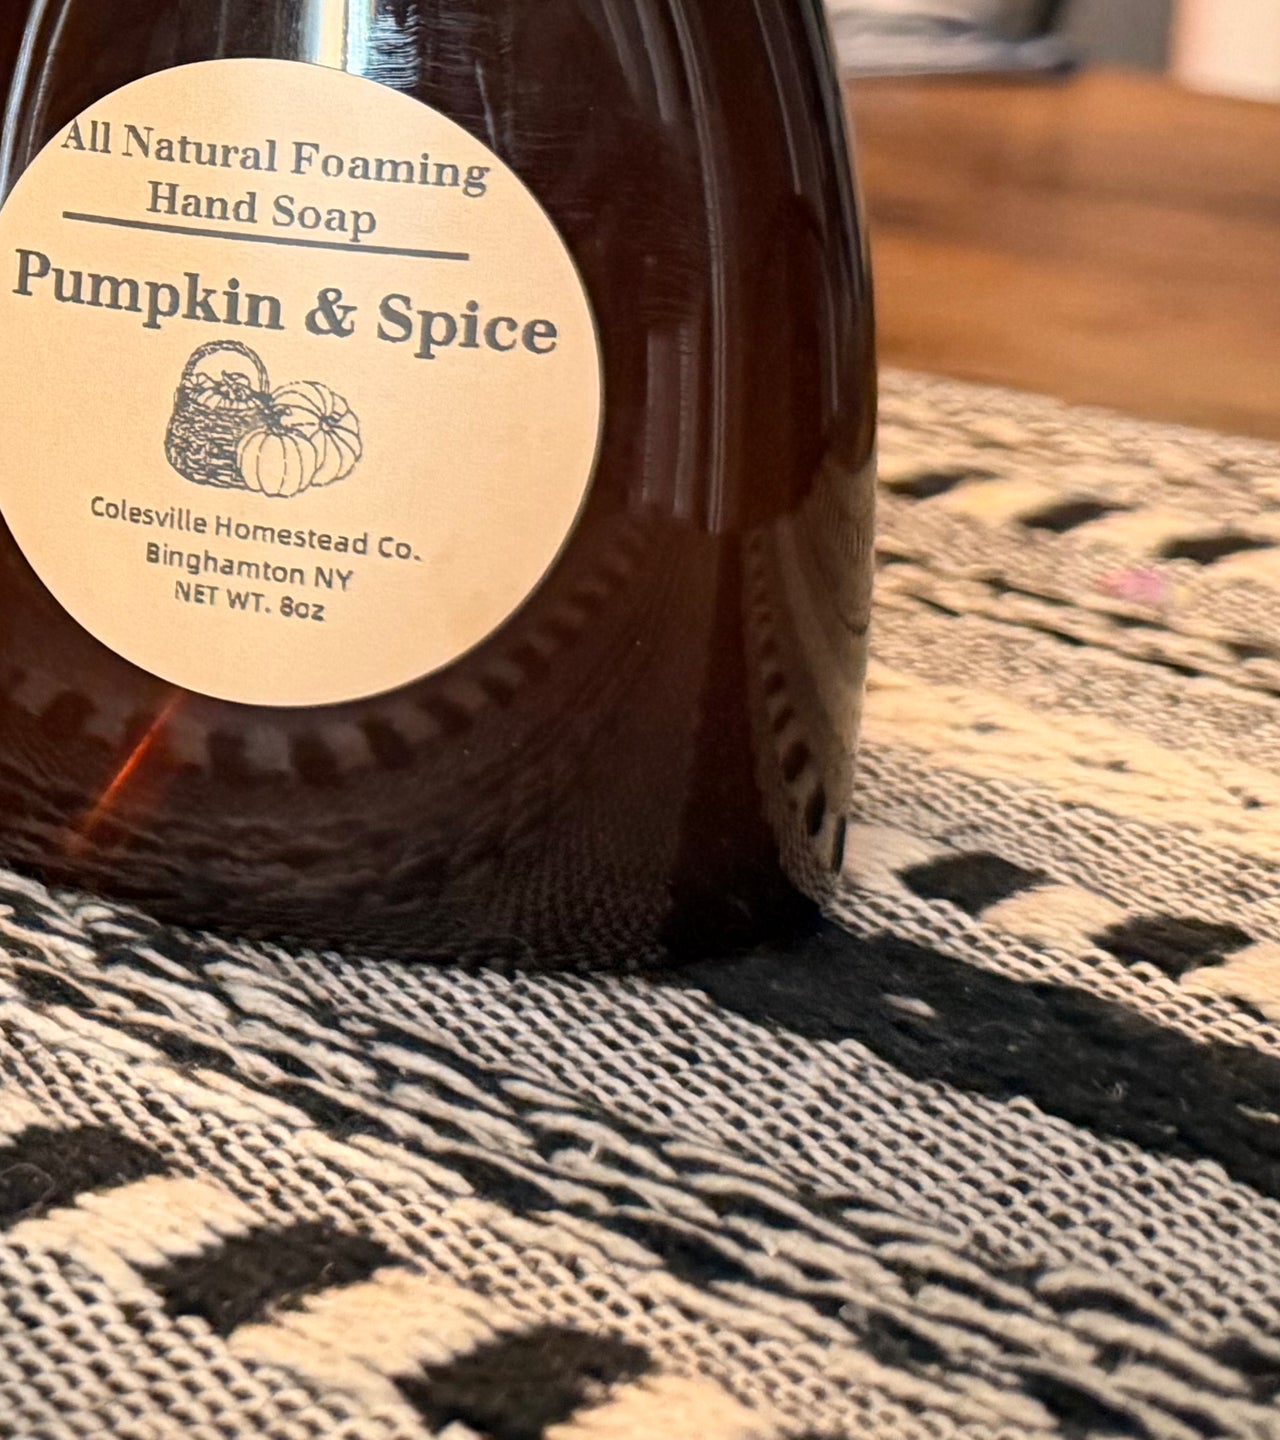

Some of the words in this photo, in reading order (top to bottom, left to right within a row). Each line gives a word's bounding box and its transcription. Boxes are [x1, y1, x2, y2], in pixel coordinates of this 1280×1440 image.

[60, 118, 111, 154] All
[122, 123, 276, 173] Natural
[289, 141, 491, 197] Foaming
[146, 180, 257, 225] Hand
[272, 194, 377, 242] Soap
[12, 247, 286, 331] Pumpkin
[304, 286, 358, 339] &
[376, 293, 558, 360] Spice
[90, 496, 208, 534] Colesville
[214, 515, 369, 556] Homestead
[377, 535, 422, 561] Co.
[146, 542, 305, 587] Binghamton
[314, 568, 354, 591] NY
[174, 580, 219, 605] NET
[226, 591, 271, 614] WT.
[279, 595, 326, 621] 8oz
